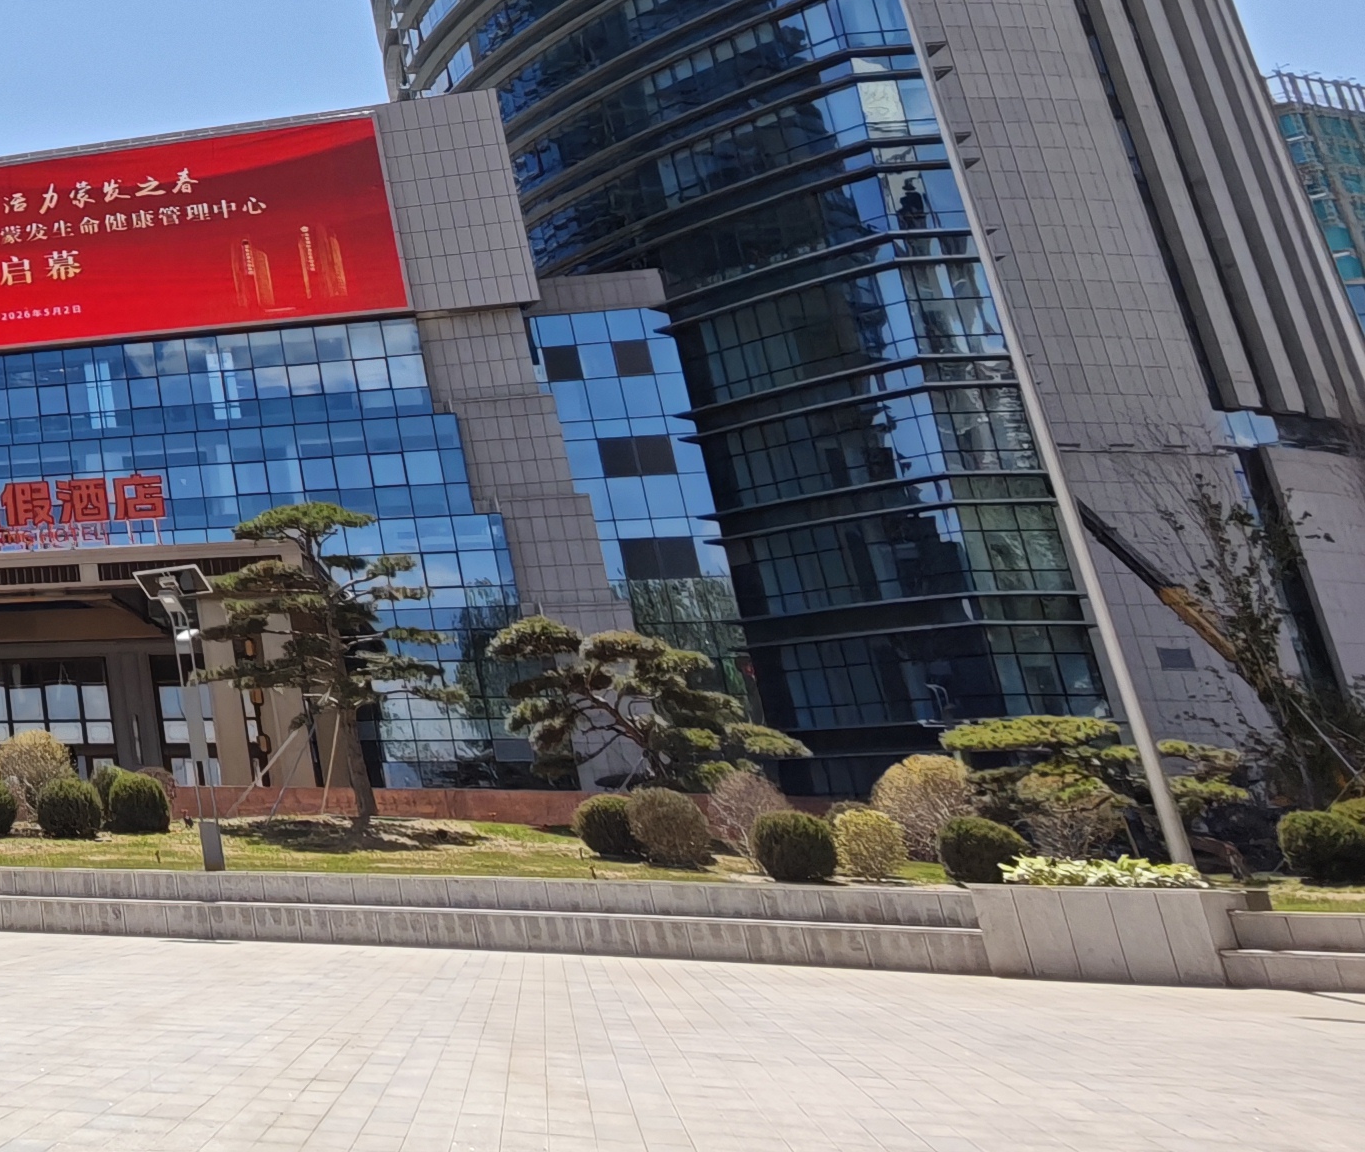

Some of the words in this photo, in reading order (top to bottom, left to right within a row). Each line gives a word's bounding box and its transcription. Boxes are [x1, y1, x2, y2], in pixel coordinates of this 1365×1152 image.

[2, 167, 199, 215] 活力蒙发之春
[40, 525, 106, 544] HOTEL
